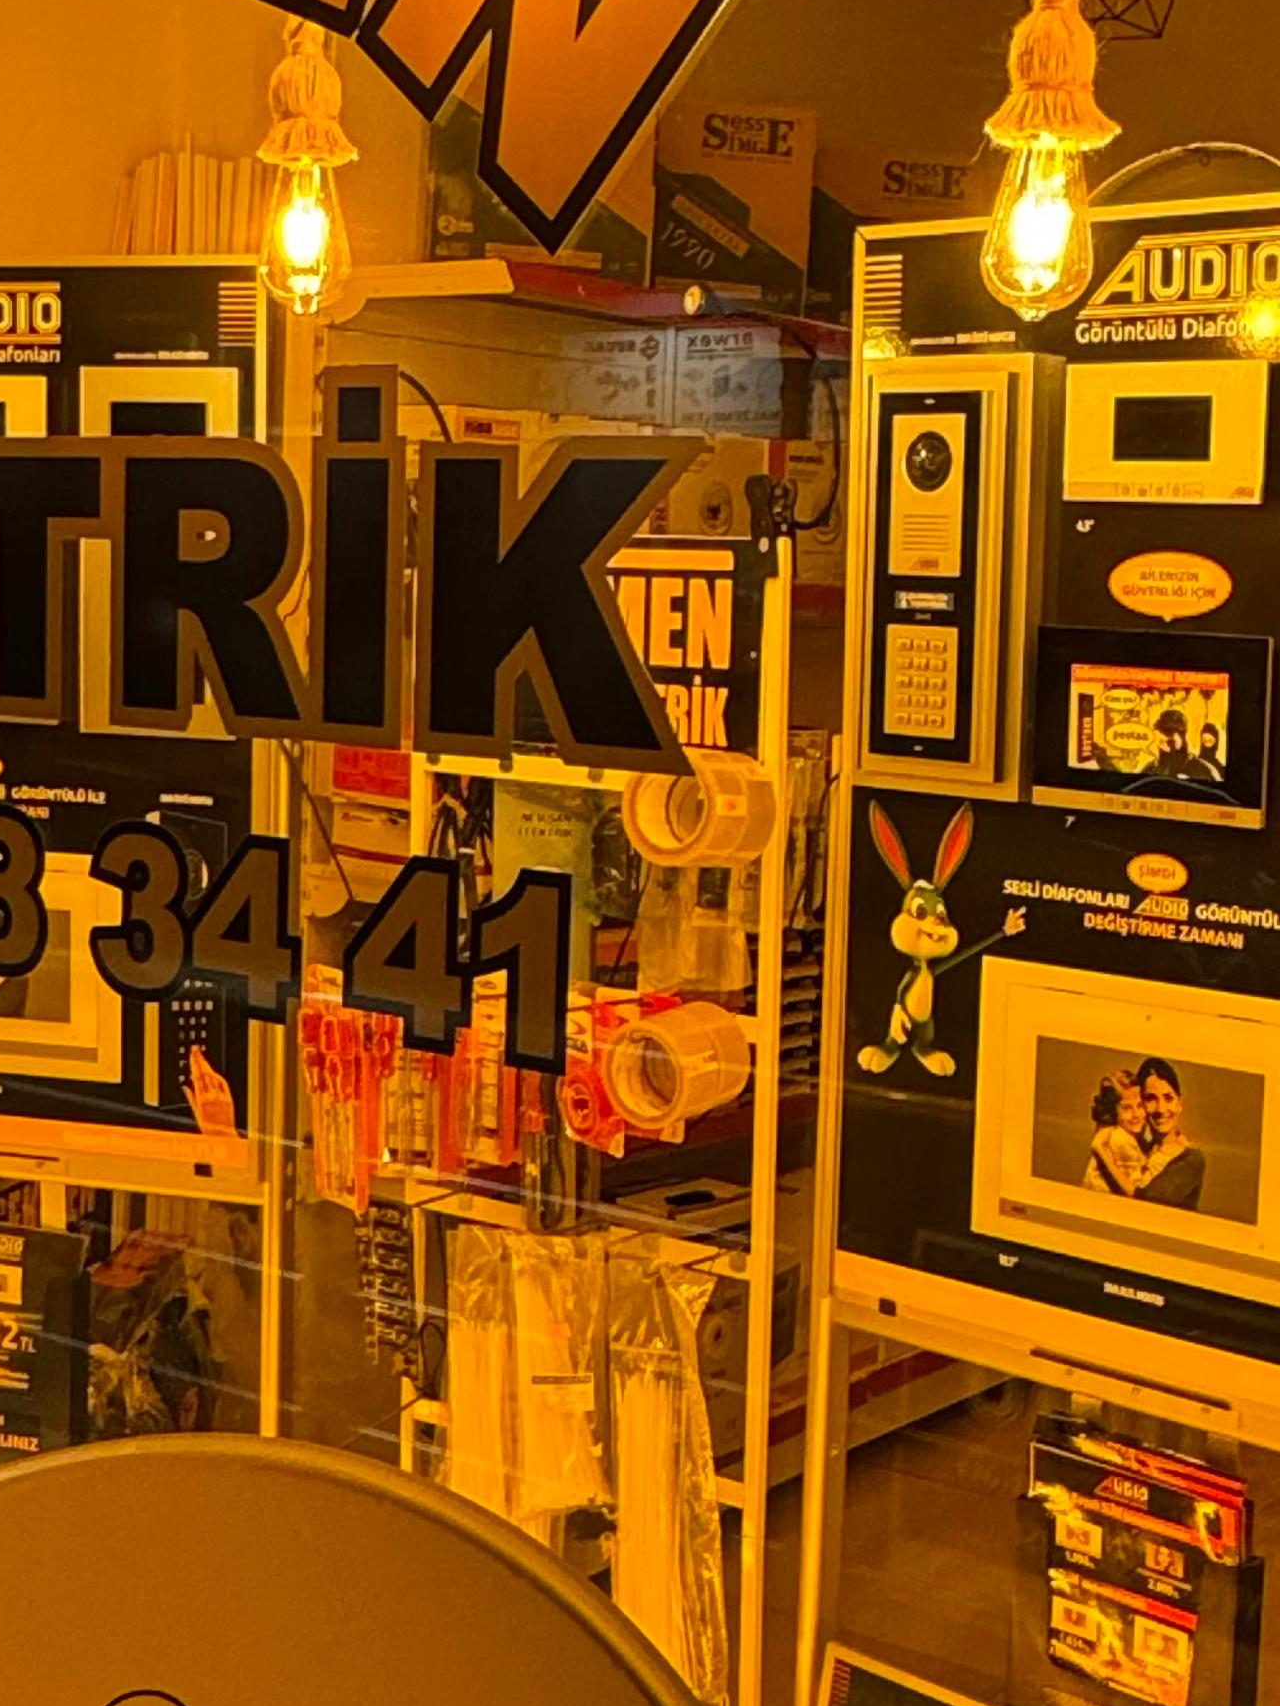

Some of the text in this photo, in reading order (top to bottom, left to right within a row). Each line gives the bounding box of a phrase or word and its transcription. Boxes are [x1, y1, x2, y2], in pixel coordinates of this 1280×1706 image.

[1075, 319, 1177, 344] Görüntülü
[1002, 878, 1040, 895] SESLİ
[1041, 882, 1130, 910] DİAFONLARI
[1133, 895, 1189, 920] AUDIO
[91, 822, 302, 1027] 34
[342, 855, 573, 1077] 41
[1083, 911, 1245, 950] DEĞİŞTİRME ZAMANI
[20, 1336, 38, 1354] TL
